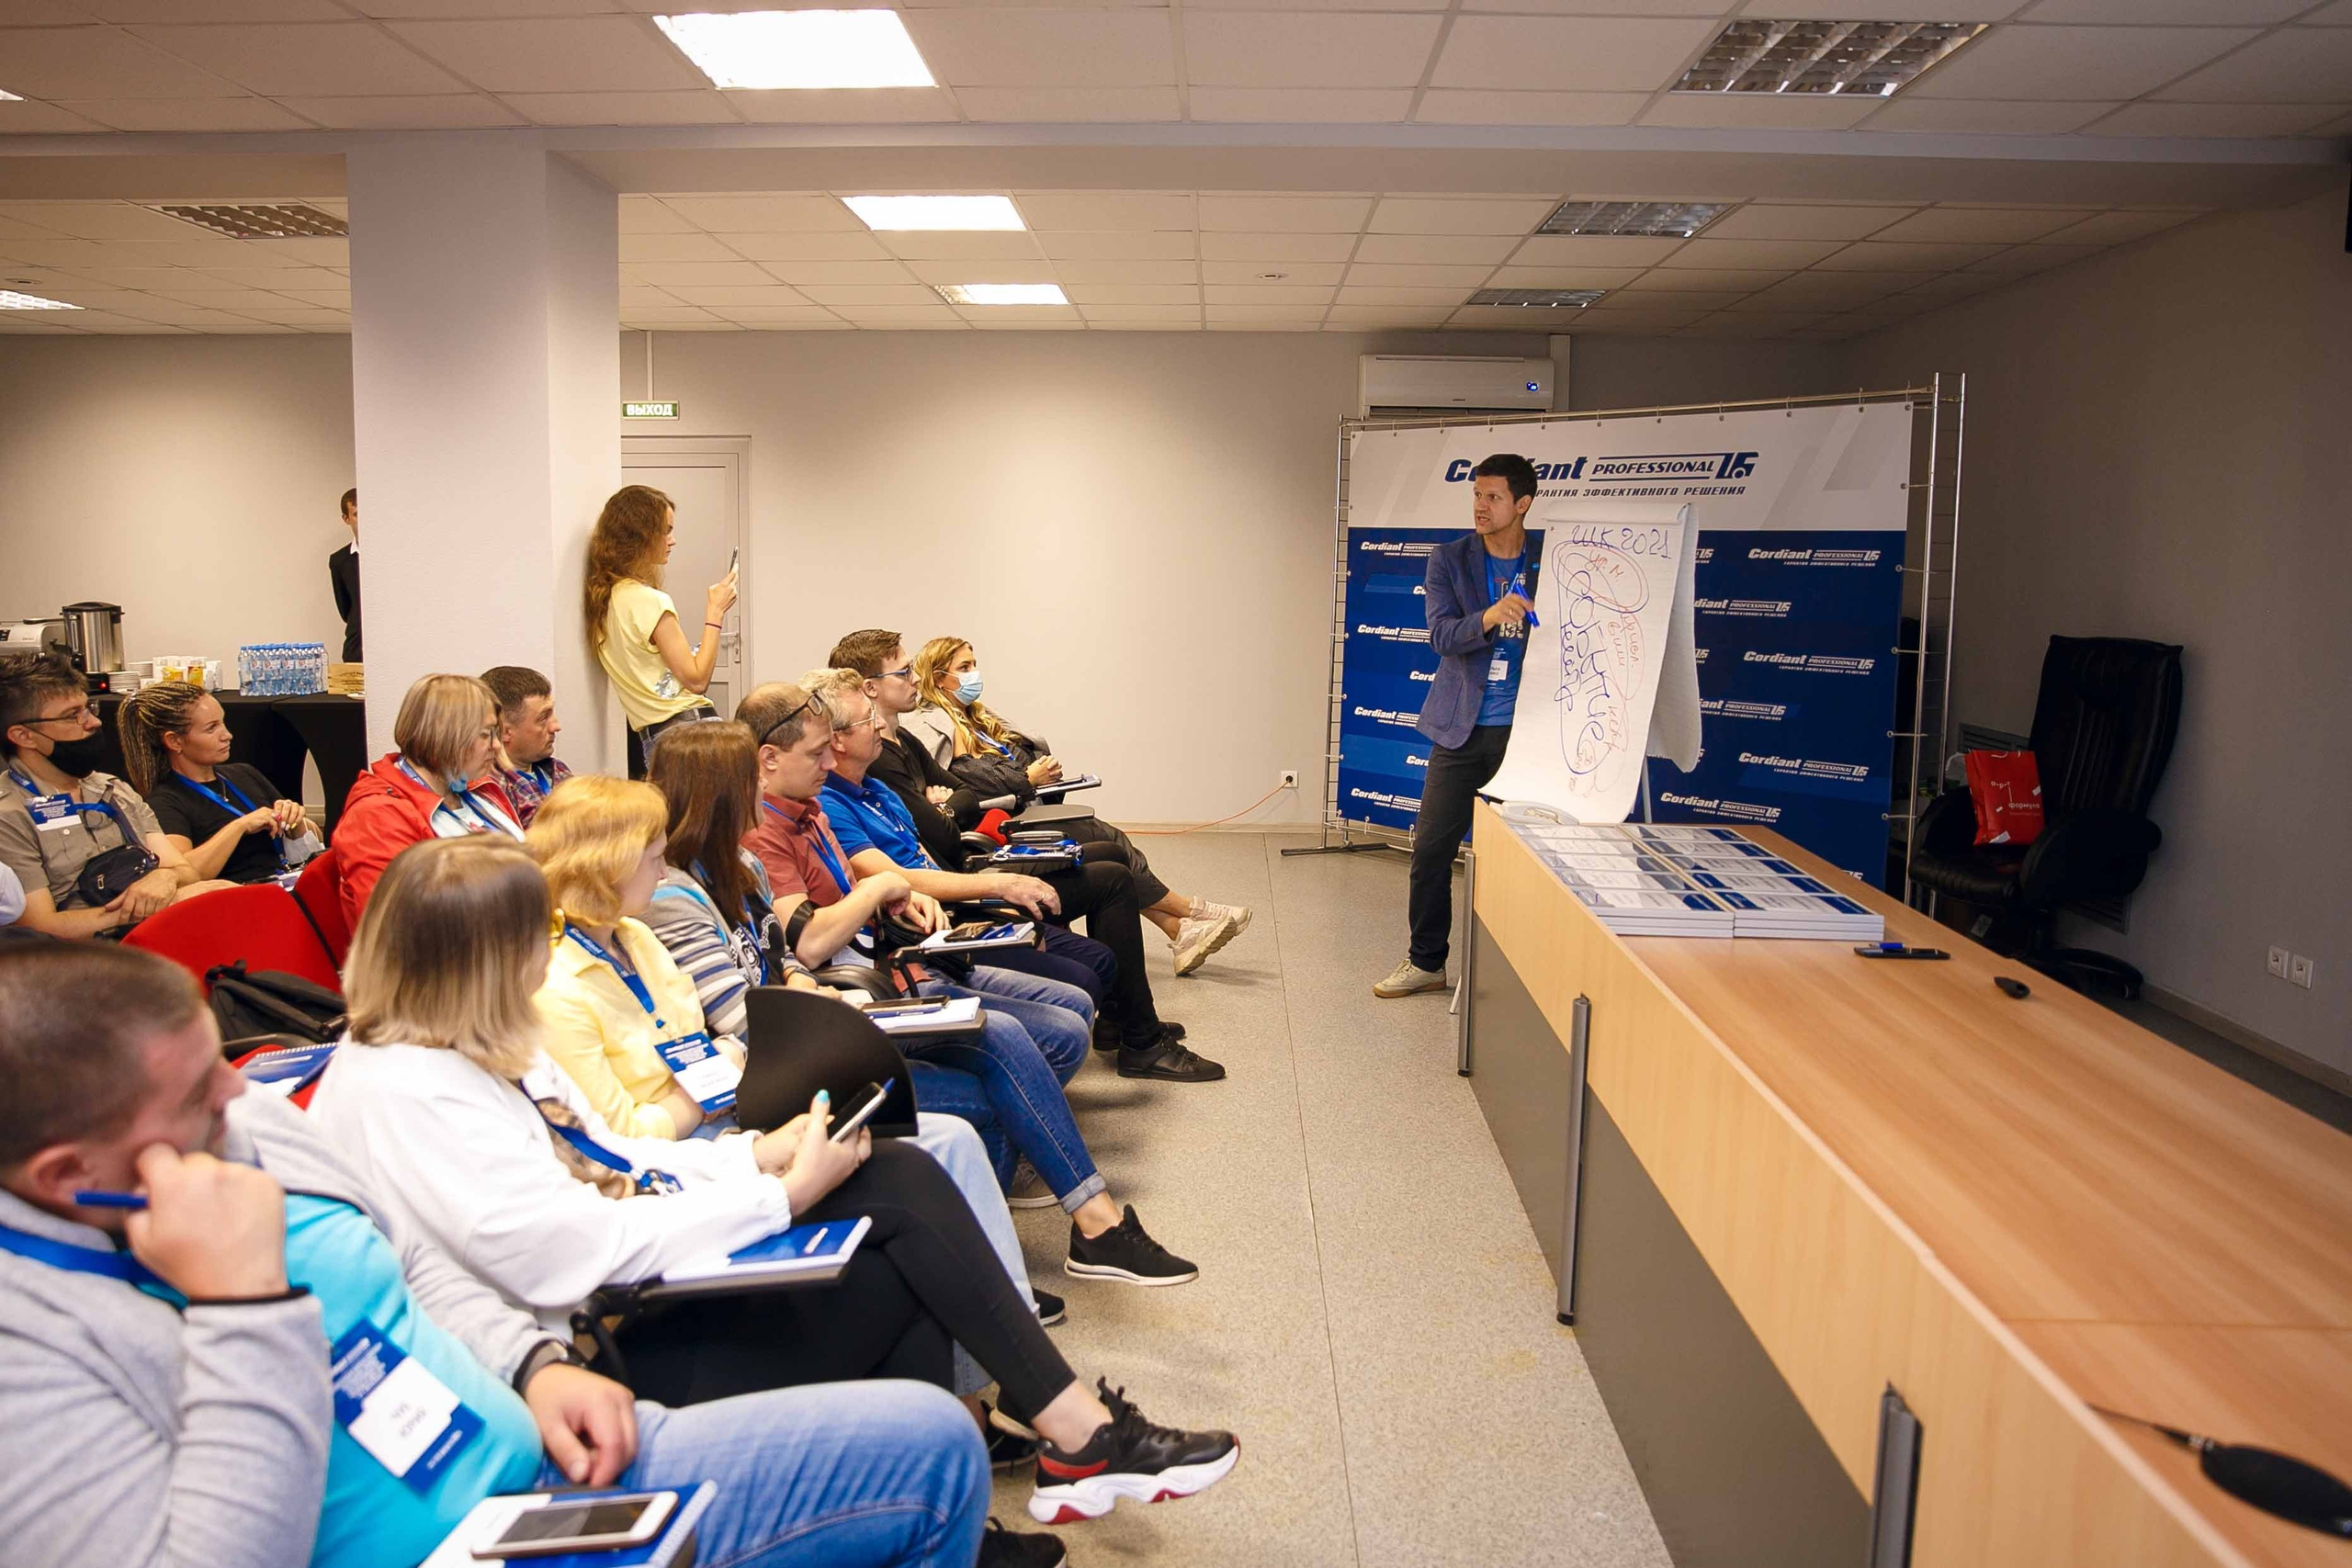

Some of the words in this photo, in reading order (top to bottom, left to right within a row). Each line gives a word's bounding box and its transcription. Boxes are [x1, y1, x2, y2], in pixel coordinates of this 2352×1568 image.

[626, 404, 673, 416] ВЫХОД
[1444, 456, 1588, 483] Cant
[1592, 459, 1714, 475] PROFESSIONAL
[1535, 489, 1578, 497] РАНТИЯ
[1582, 487, 1679, 497] ЭФФЕКТИВНОГО
[1683, 486, 1747, 496] РЕШЕНИЯ
[1361, 541, 1404, 551] Cordiant
[1621, 527, 1672, 559] 2021
[1747, 547, 1813, 559] Cordiant
[1694, 598, 1729, 609] diant
[1357, 624, 1400, 636] Cordiant
[1743, 650, 1807, 664] Cordiant
[1409, 671, 1436, 682] Cord
[1354, 706, 1396, 719] Cordiant
[1738, 751, 1802, 768] Cordiant
[1351, 787, 1393, 802] Cordiant
[1660, 792, 1719, 808] Cordiant
